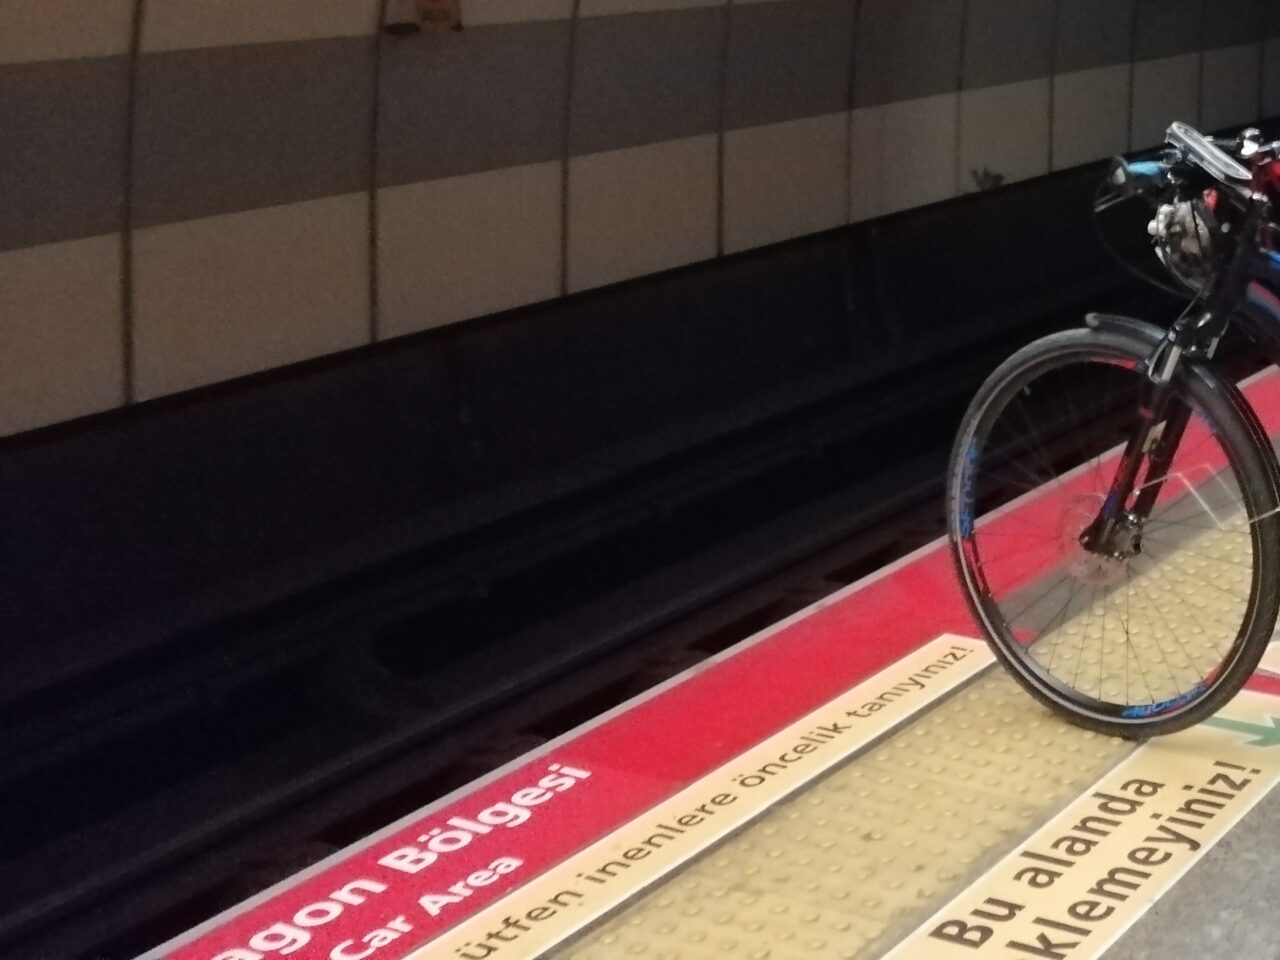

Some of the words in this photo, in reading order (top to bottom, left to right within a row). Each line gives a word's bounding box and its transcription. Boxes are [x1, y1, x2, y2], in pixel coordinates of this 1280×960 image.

[378, 763, 592, 875] Bölgesi
[576, 791, 740, 885] inenlere
[737, 721, 853, 790] öncelik
[846, 646, 976, 720] tanıyınız!
[329, 915, 414, 960] Car
[417, 856, 523, 917] Area
[927, 897, 1026, 949] Bu
[1013, 778, 1166, 889] alanda
